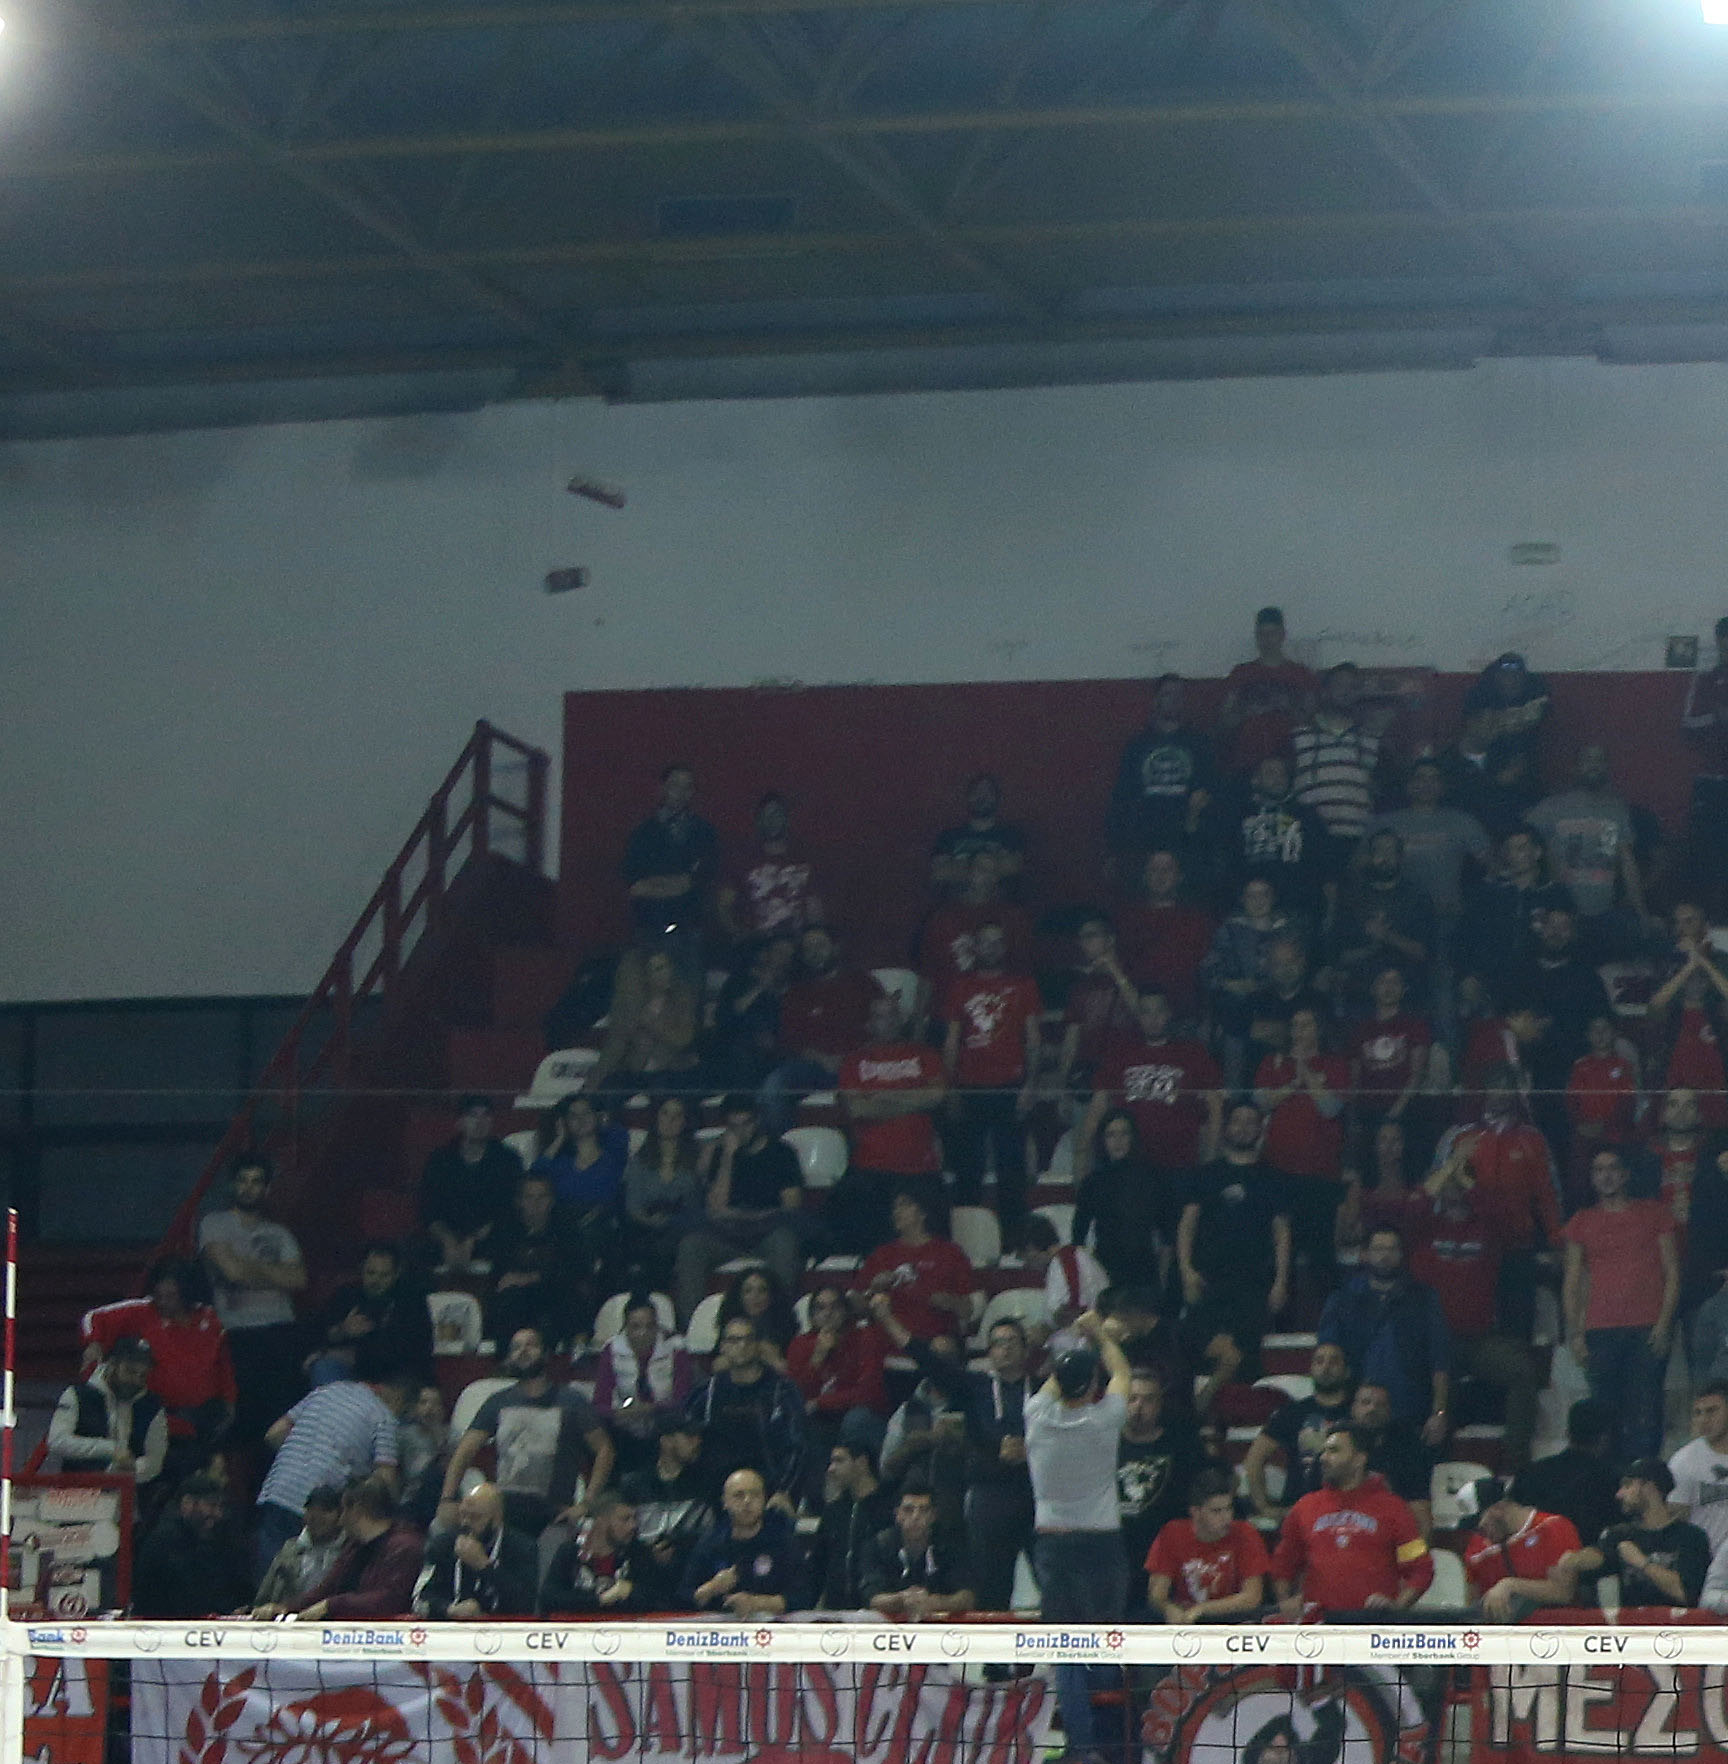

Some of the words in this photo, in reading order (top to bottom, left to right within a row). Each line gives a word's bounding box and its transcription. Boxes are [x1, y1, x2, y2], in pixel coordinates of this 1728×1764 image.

[184, 1630, 228, 1647] CEV
[321, 1630, 404, 1645] DenizBank
[525, 1633, 570, 1649] CEV
[666, 1632, 749, 1647] DenizBank
[873, 1635, 917, 1651] CEV
[1016, 1633, 1100, 1648] DenizBank
[1226, 1636, 1270, 1652] CEV
[1370, 1634, 1457, 1649] DenizBank
[1584, 1637, 1629, 1653] CEV
